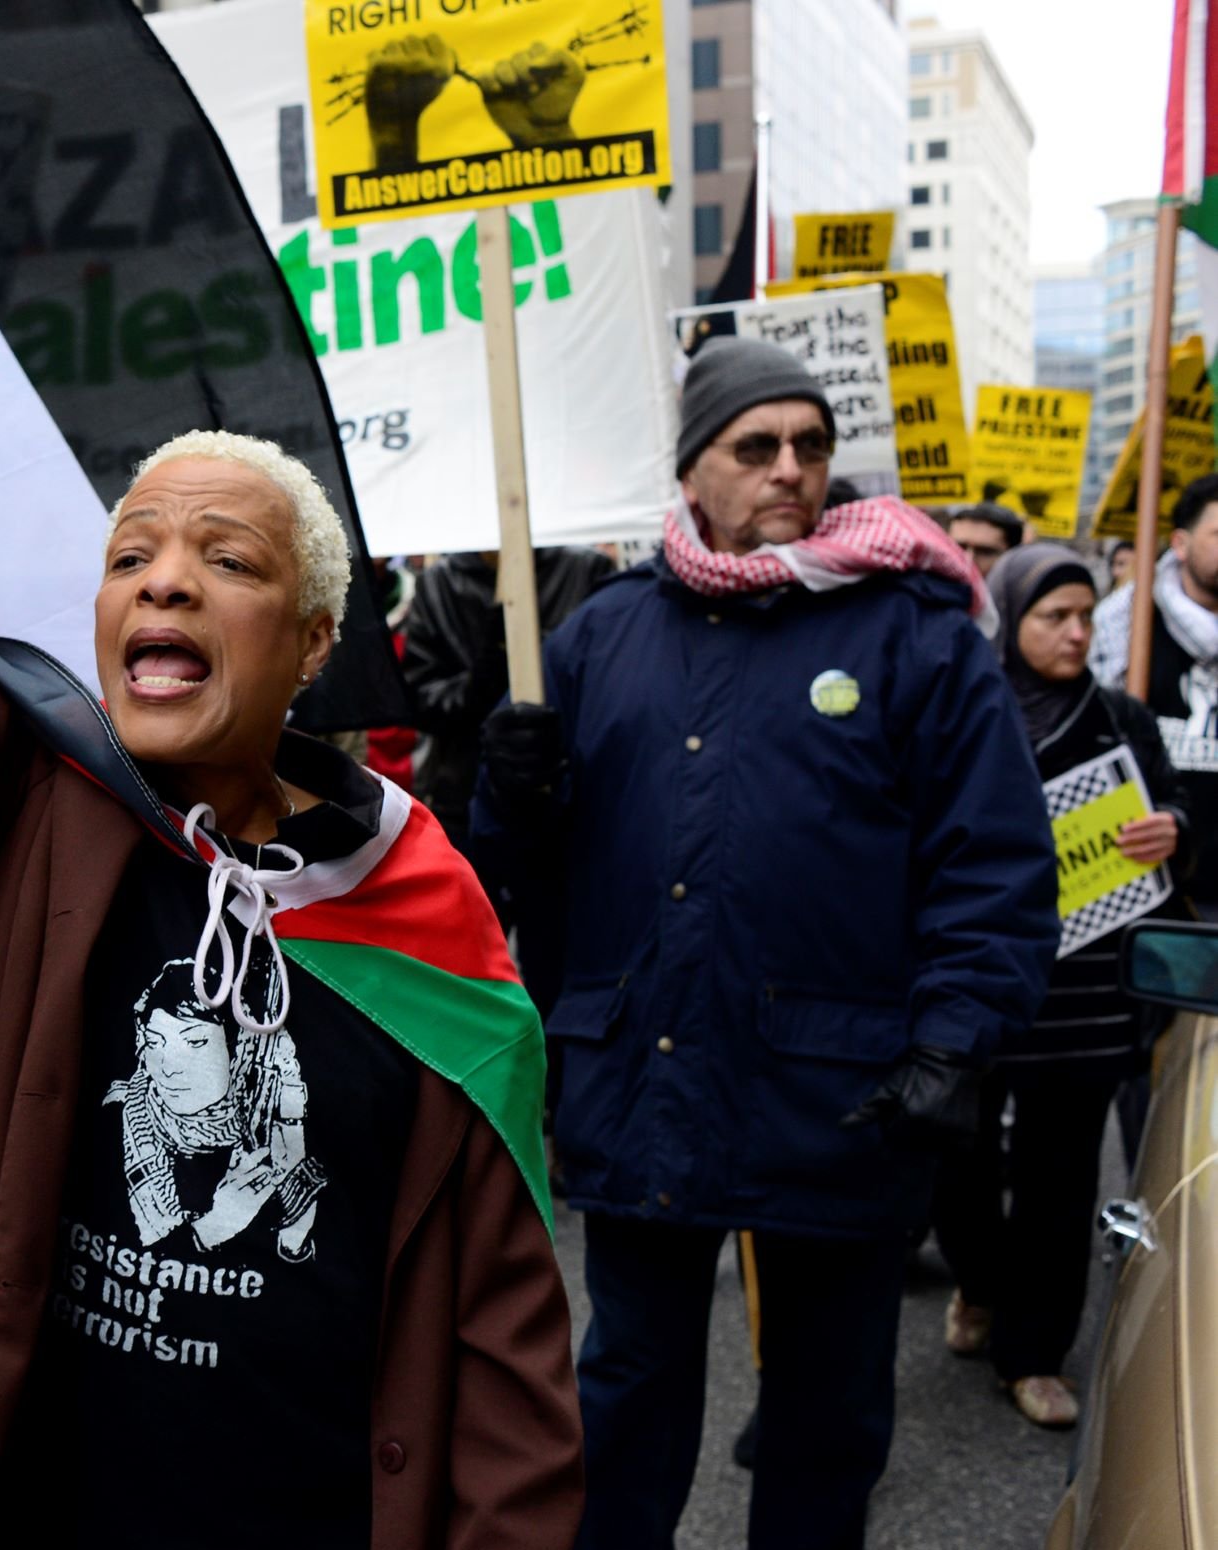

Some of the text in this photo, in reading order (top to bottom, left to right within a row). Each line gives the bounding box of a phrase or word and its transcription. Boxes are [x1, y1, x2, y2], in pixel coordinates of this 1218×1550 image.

[329, 0, 421, 35] RIGHT
[345, 140, 644, 211] AnswerCoalition.org
[818, 222, 874, 258] FREE
[888, 339, 949, 369] ding
[1000, 393, 1062, 418] FREE
[978, 419, 1081, 442] PALESTINE
[68, 1222, 265, 1298] esistance
[102, 1275, 164, 1323] not
[53, 1293, 219, 1369] errorism
